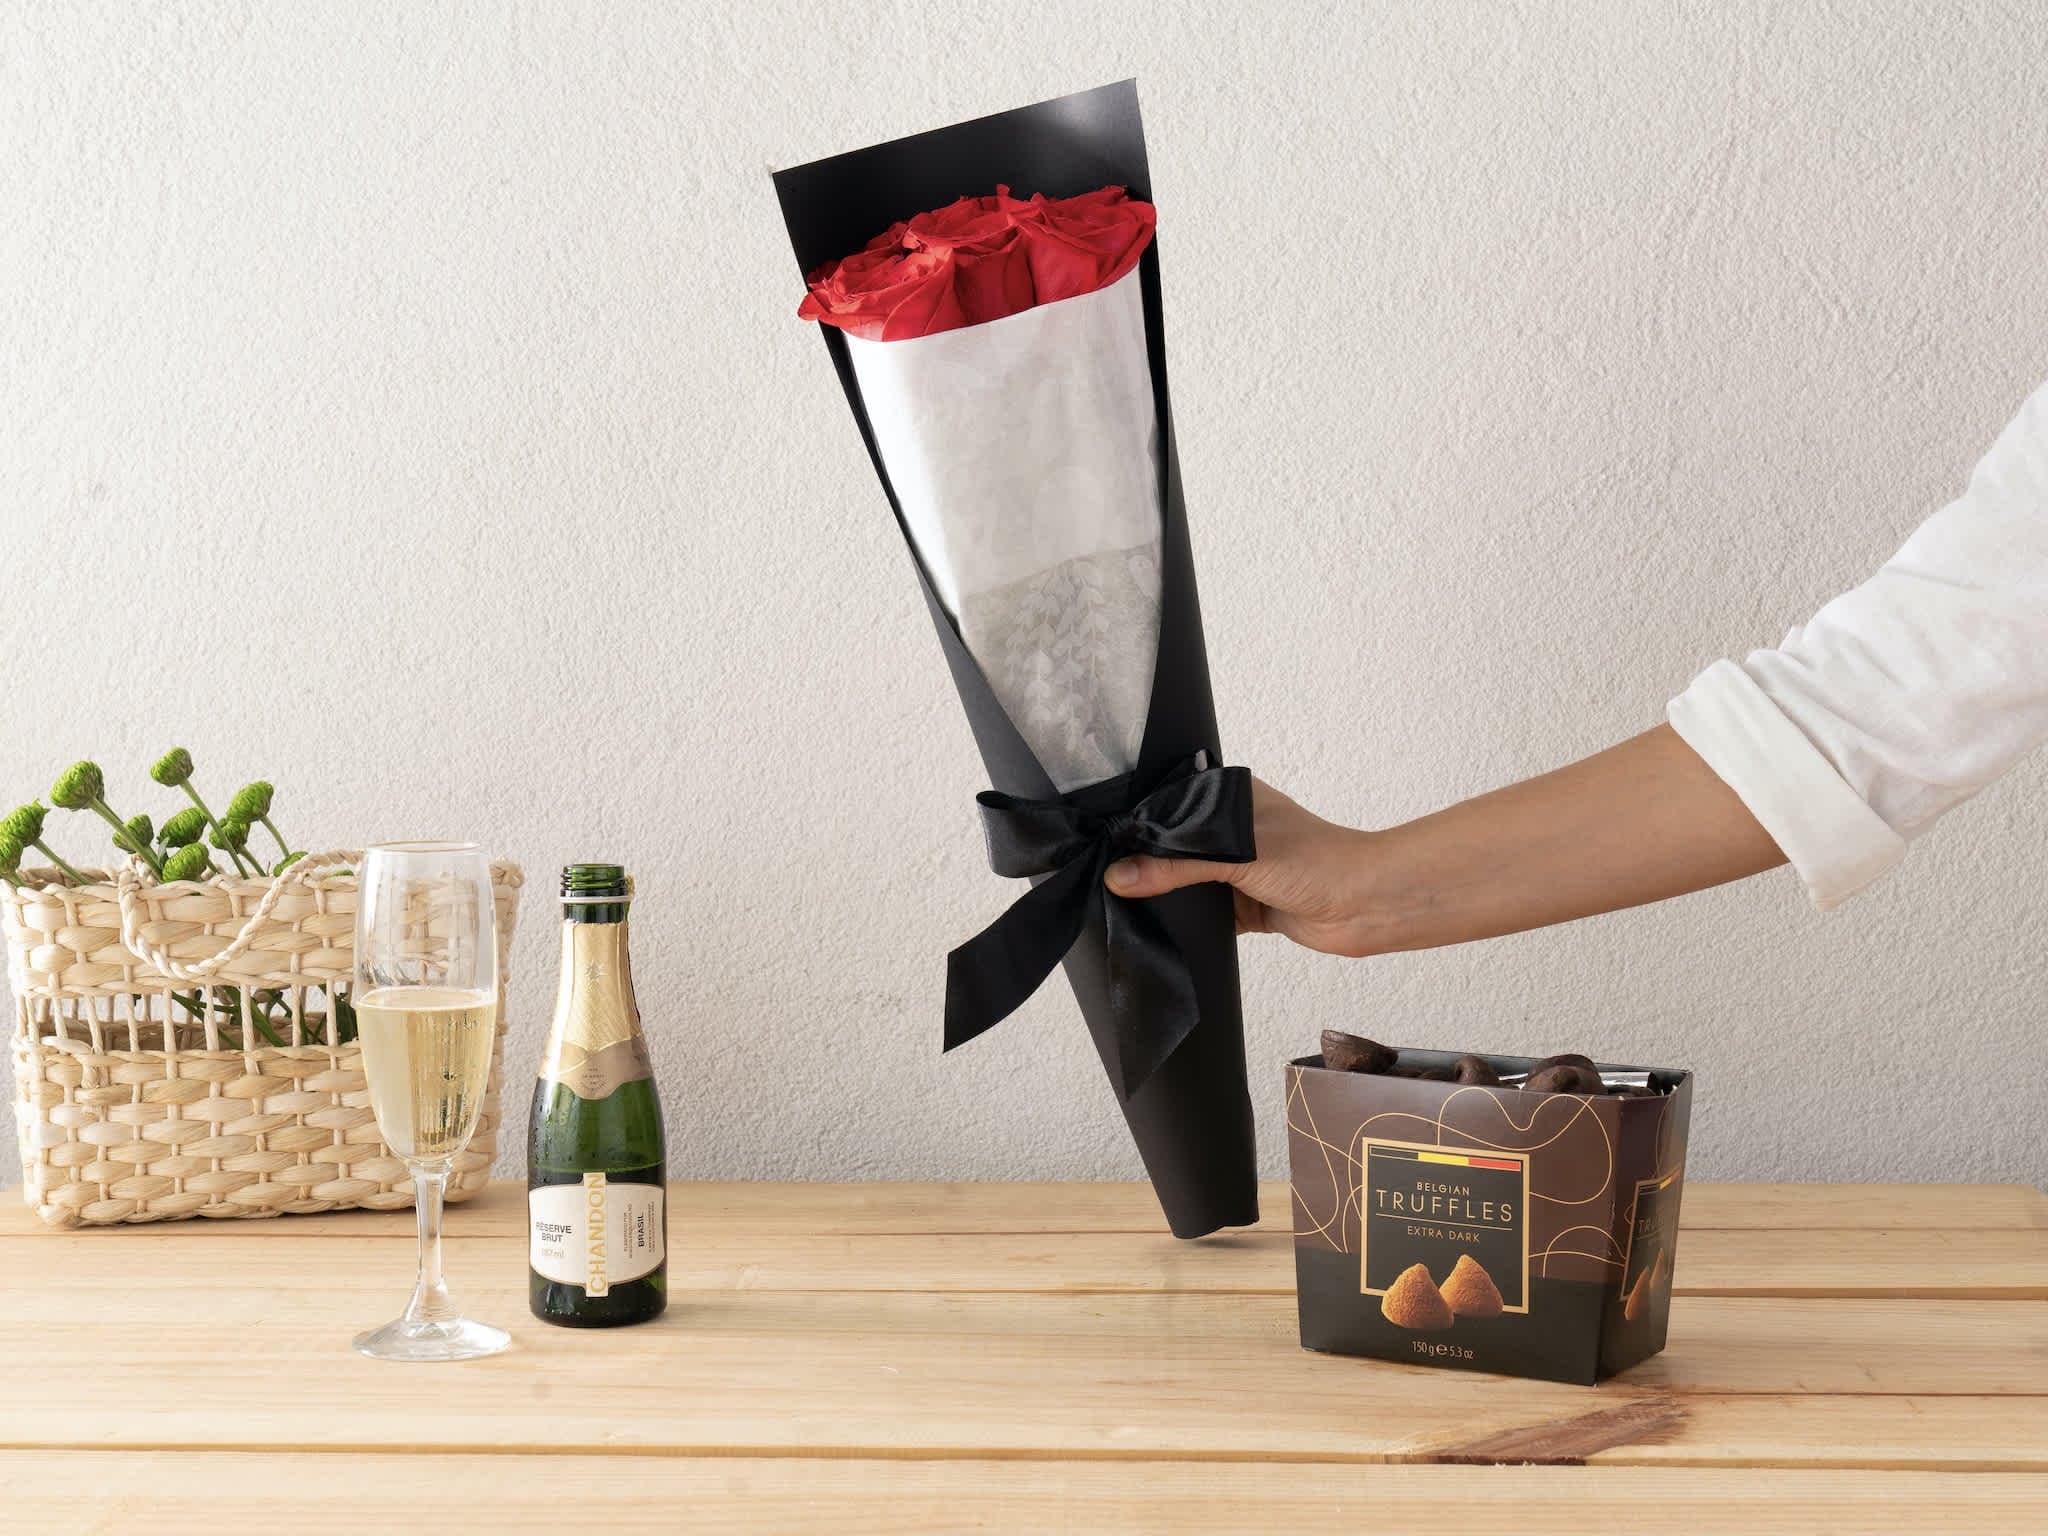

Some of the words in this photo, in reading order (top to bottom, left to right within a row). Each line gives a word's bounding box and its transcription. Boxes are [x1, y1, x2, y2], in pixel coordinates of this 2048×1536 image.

[1416, 1181, 1470, 1196] BELGIAN
[1376, 1189, 1512, 1222] TRUFFLES
[541, 1232, 564, 1243] BRUT
[589, 1174, 606, 1292] CHANDON
[1407, 1225, 1444, 1240] EXTRA
[1449, 1230, 1481, 1243] DARK
[1412, 1341, 1427, 1352] 150
